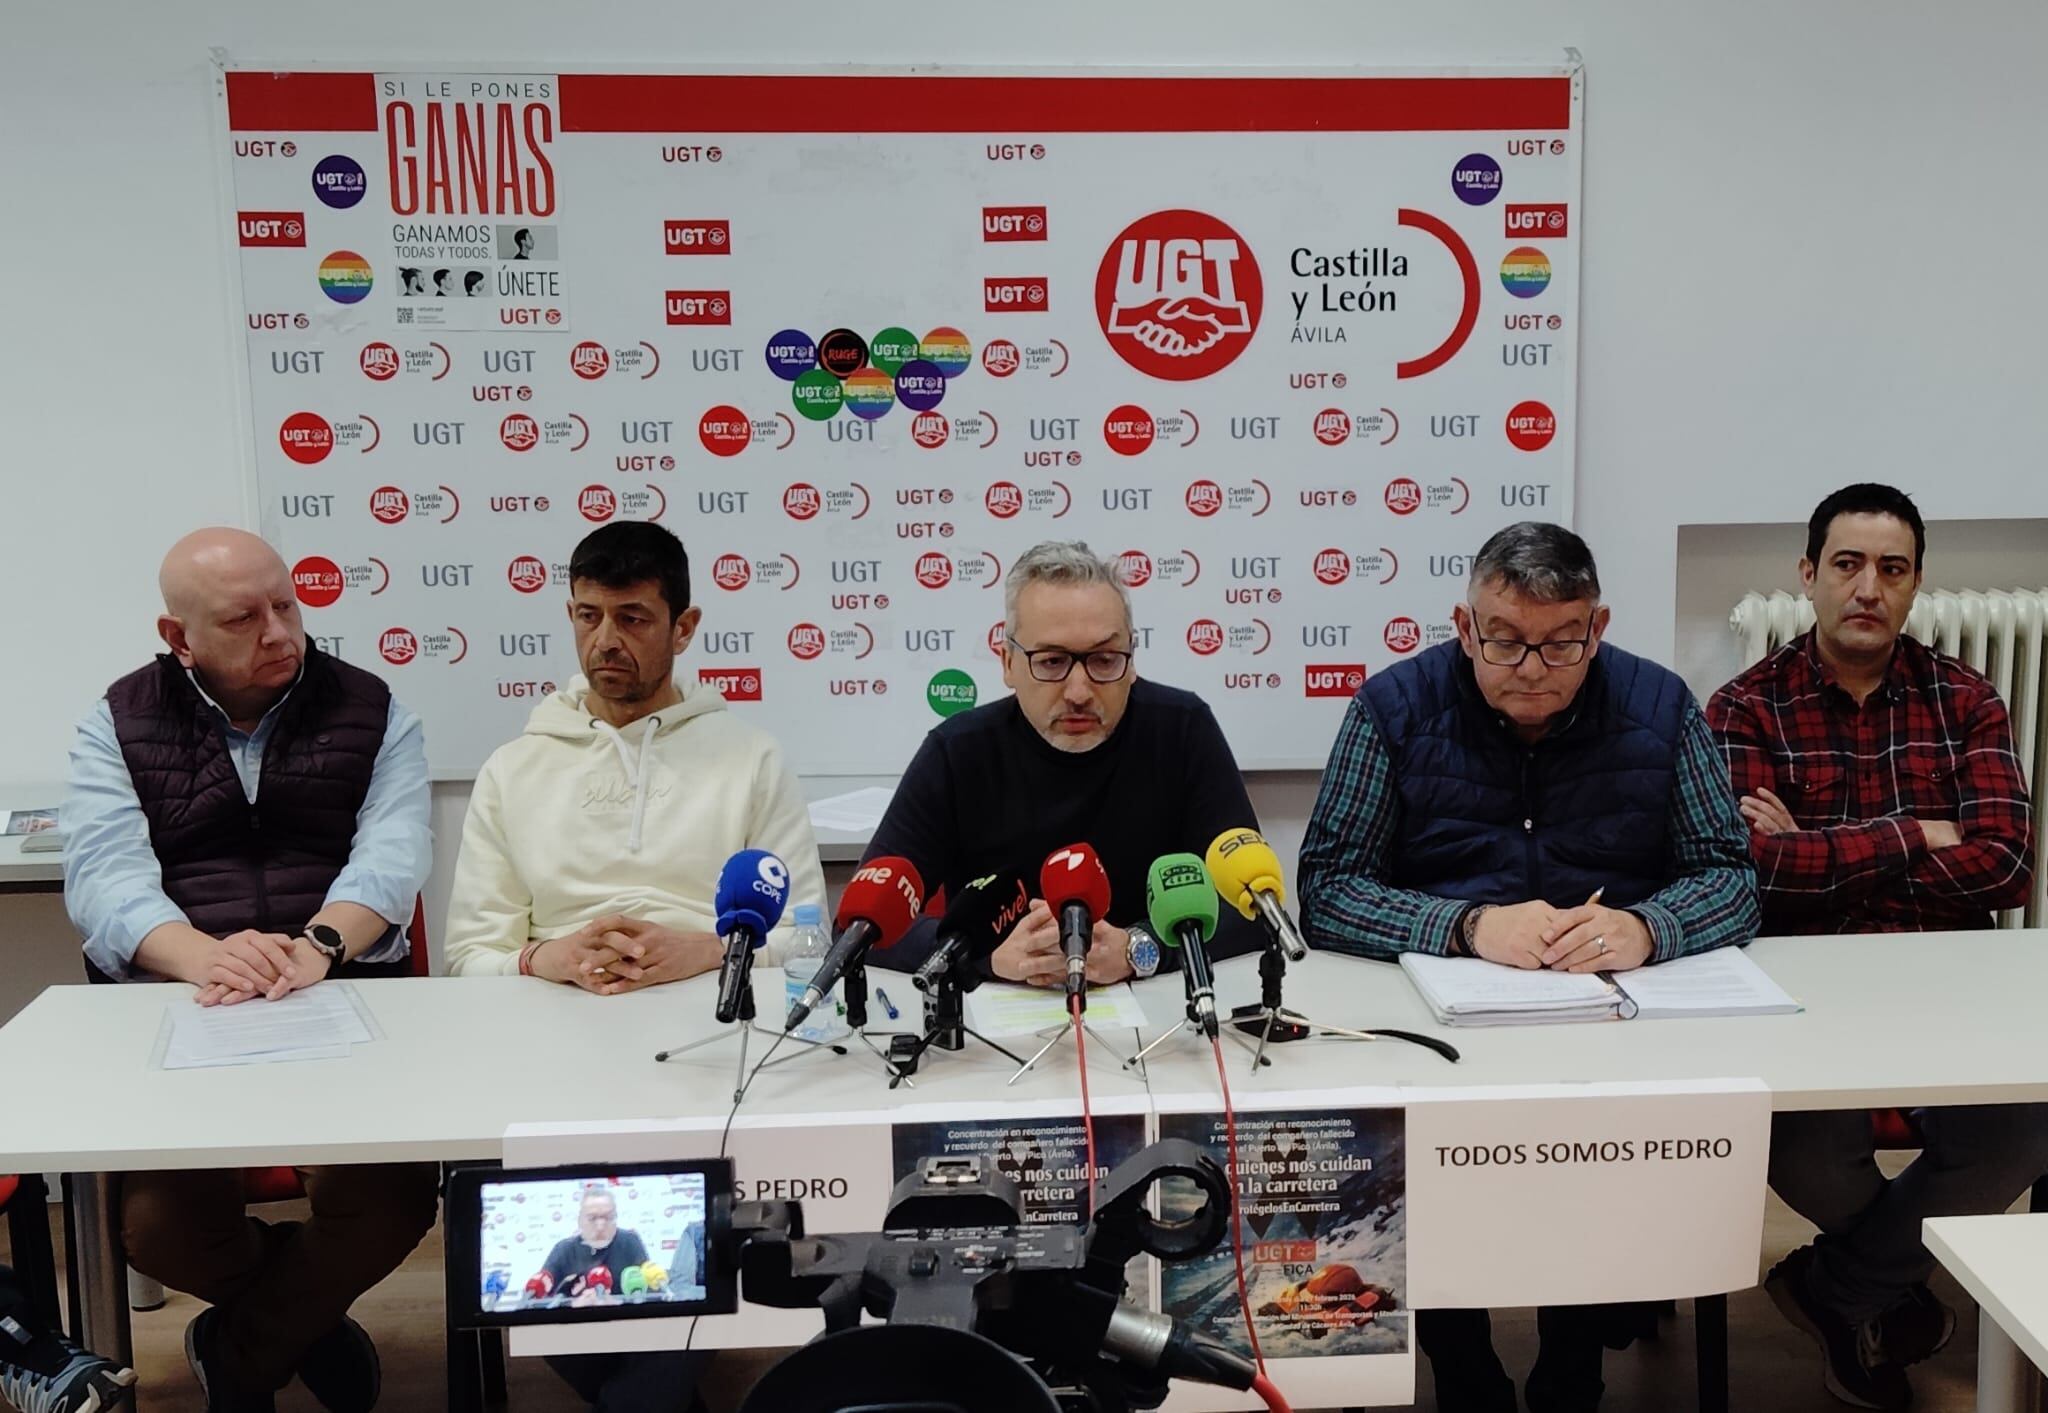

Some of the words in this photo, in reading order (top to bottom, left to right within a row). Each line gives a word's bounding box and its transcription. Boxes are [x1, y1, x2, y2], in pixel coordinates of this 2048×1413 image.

[385, 82, 404, 96] SI
[426, 82, 450, 96] LE
[472, 83, 549, 98] PONES
[235, 141, 276, 157] UGT
[663, 147, 702, 162] UGT
[987, 145, 1026, 160] UGT
[1508, 140, 1546, 155] UGT
[386, 102, 555, 217] GANAS
[317, 173, 344, 184] UGT
[1456, 170, 1482, 182] UGT
[986, 216, 1024, 232] UGT
[1508, 212, 1545, 229] UGT
[241, 221, 281, 237] UGT
[393, 224, 490, 243] GANAMOS
[667, 228, 706, 245] UGT
[394, 246, 435, 260] TODAS
[438, 247, 445, 259] Y
[1115, 239, 1239, 301] UGT
[1291, 248, 1407, 277] Castilla
[498, 266, 560, 297] ÚNETE
[987, 286, 1025, 303] UGT
[1292, 292, 1308, 320] y
[1323, 281, 1395, 311] León
[668, 299, 707, 315] UGT
[249, 314, 289, 329] UGT
[501, 309, 541, 324] UGT
[1505, 315, 1543, 330] UGT
[1291, 322, 1346, 342] ÁVILA
[365, 348, 393, 365] UGT
[405, 351, 433, 359] Castilla
[615, 350, 642, 358] Castilla
[770, 346, 794, 357] UGT
[829, 348, 858, 360] RUGE
[874, 345, 899, 356] UGT
[987, 345, 1015, 361] UGT
[1026, 348, 1052, 356] Castilla
[1503, 344, 1552, 366] UGT
[272, 351, 324, 373] UGT
[484, 351, 536, 372] UGT
[693, 349, 743, 371] UGT
[899, 378, 924, 388] UGT
[1290, 373, 1328, 389] UGT
[473, 386, 512, 401] UGT
[796, 387, 821, 398] UGT
[506, 420, 534, 435] UGT
[704, 423, 728, 433] UGT
[916, 417, 943, 433] UGT
[1108, 422, 1134, 433] UGT
[1232, 417, 1280, 439] UGT
[1318, 414, 1346, 430] UGT
[1357, 416, 1383, 424] Castilla
[1431, 416, 1480, 437] UGT
[1510, 418, 1535, 429] UGT
[284, 430, 310, 441] UGT
[414, 423, 464, 445] UGT
[622, 422, 672, 443] UGT
[827, 420, 877, 442] UGT
[1031, 419, 1080, 440] UGT
[617, 456, 655, 471] UGT
[1025, 452, 1062, 467] UGT
[375, 492, 404, 508] UGT
[583, 490, 611, 506] UGT
[788, 489, 816, 505] UGT
[897, 490, 934, 505] UGT
[1103, 489, 1152, 510] UGT
[1192, 485, 1217, 500] UGT
[1301, 491, 1338, 506] UGT
[1502, 485, 1550, 506] UGT
[283, 496, 334, 517] UGT
[491, 497, 530, 512] UGT
[699, 492, 748, 513] UGT
[897, 523, 935, 538] UGT
[512, 562, 541, 577] UGT
[1232, 558, 1280, 578] UGT
[1318, 554, 1346, 570] UGT
[295, 573, 320, 584] UGT
[423, 565, 473, 586] UGT
[832, 561, 881, 582] UGT
[832, 595, 870, 609] UGT
[1226, 589, 1263, 604] UGT
[1303, 626, 1350, 647] UGT
[1389, 622, 1416, 637] UGT
[500, 634, 550, 656] UGT
[704, 632, 753, 653] UGT
[906, 630, 954, 651] UGT
[831, 680, 868, 695] UGT
[1225, 674, 1262, 688] UGT
[1308, 672, 1344, 688] UGT
[499, 682, 536, 697] UGT
[931, 685, 956, 696] UGT
[752, 878, 783, 905] COPE
[1276, 1121, 1286, 1129] en
[1287, 1118, 1351, 1129] reconocimiento
[948, 1127, 1008, 1139] Concentración
[1022, 1125, 1087, 1136] reconocimiento
[1258, 1131, 1270, 1141] del
[1320, 1128, 1355, 1139] fallecido
[952, 1141, 988, 1151] recuerdo
[992, 1139, 1006, 1149] del
[1436, 1145, 1526, 1166] TODOS
[1536, 1141, 1634, 1163] SOMOS
[1645, 1139, 1731, 1160] PEDRO
[1289, 1158, 1317, 1173] nos
[1320, 1154, 1373, 1172] cuidan
[1025, 1168, 1053, 1182] nos
[757, 1178, 848, 1199] PEDRO
[1248, 1178, 1263, 1194] la
[1266, 1177, 1338, 1193] carretera
[1021, 1186, 1075, 1202] rretera
[1255, 1243, 1295, 1262] UGT
